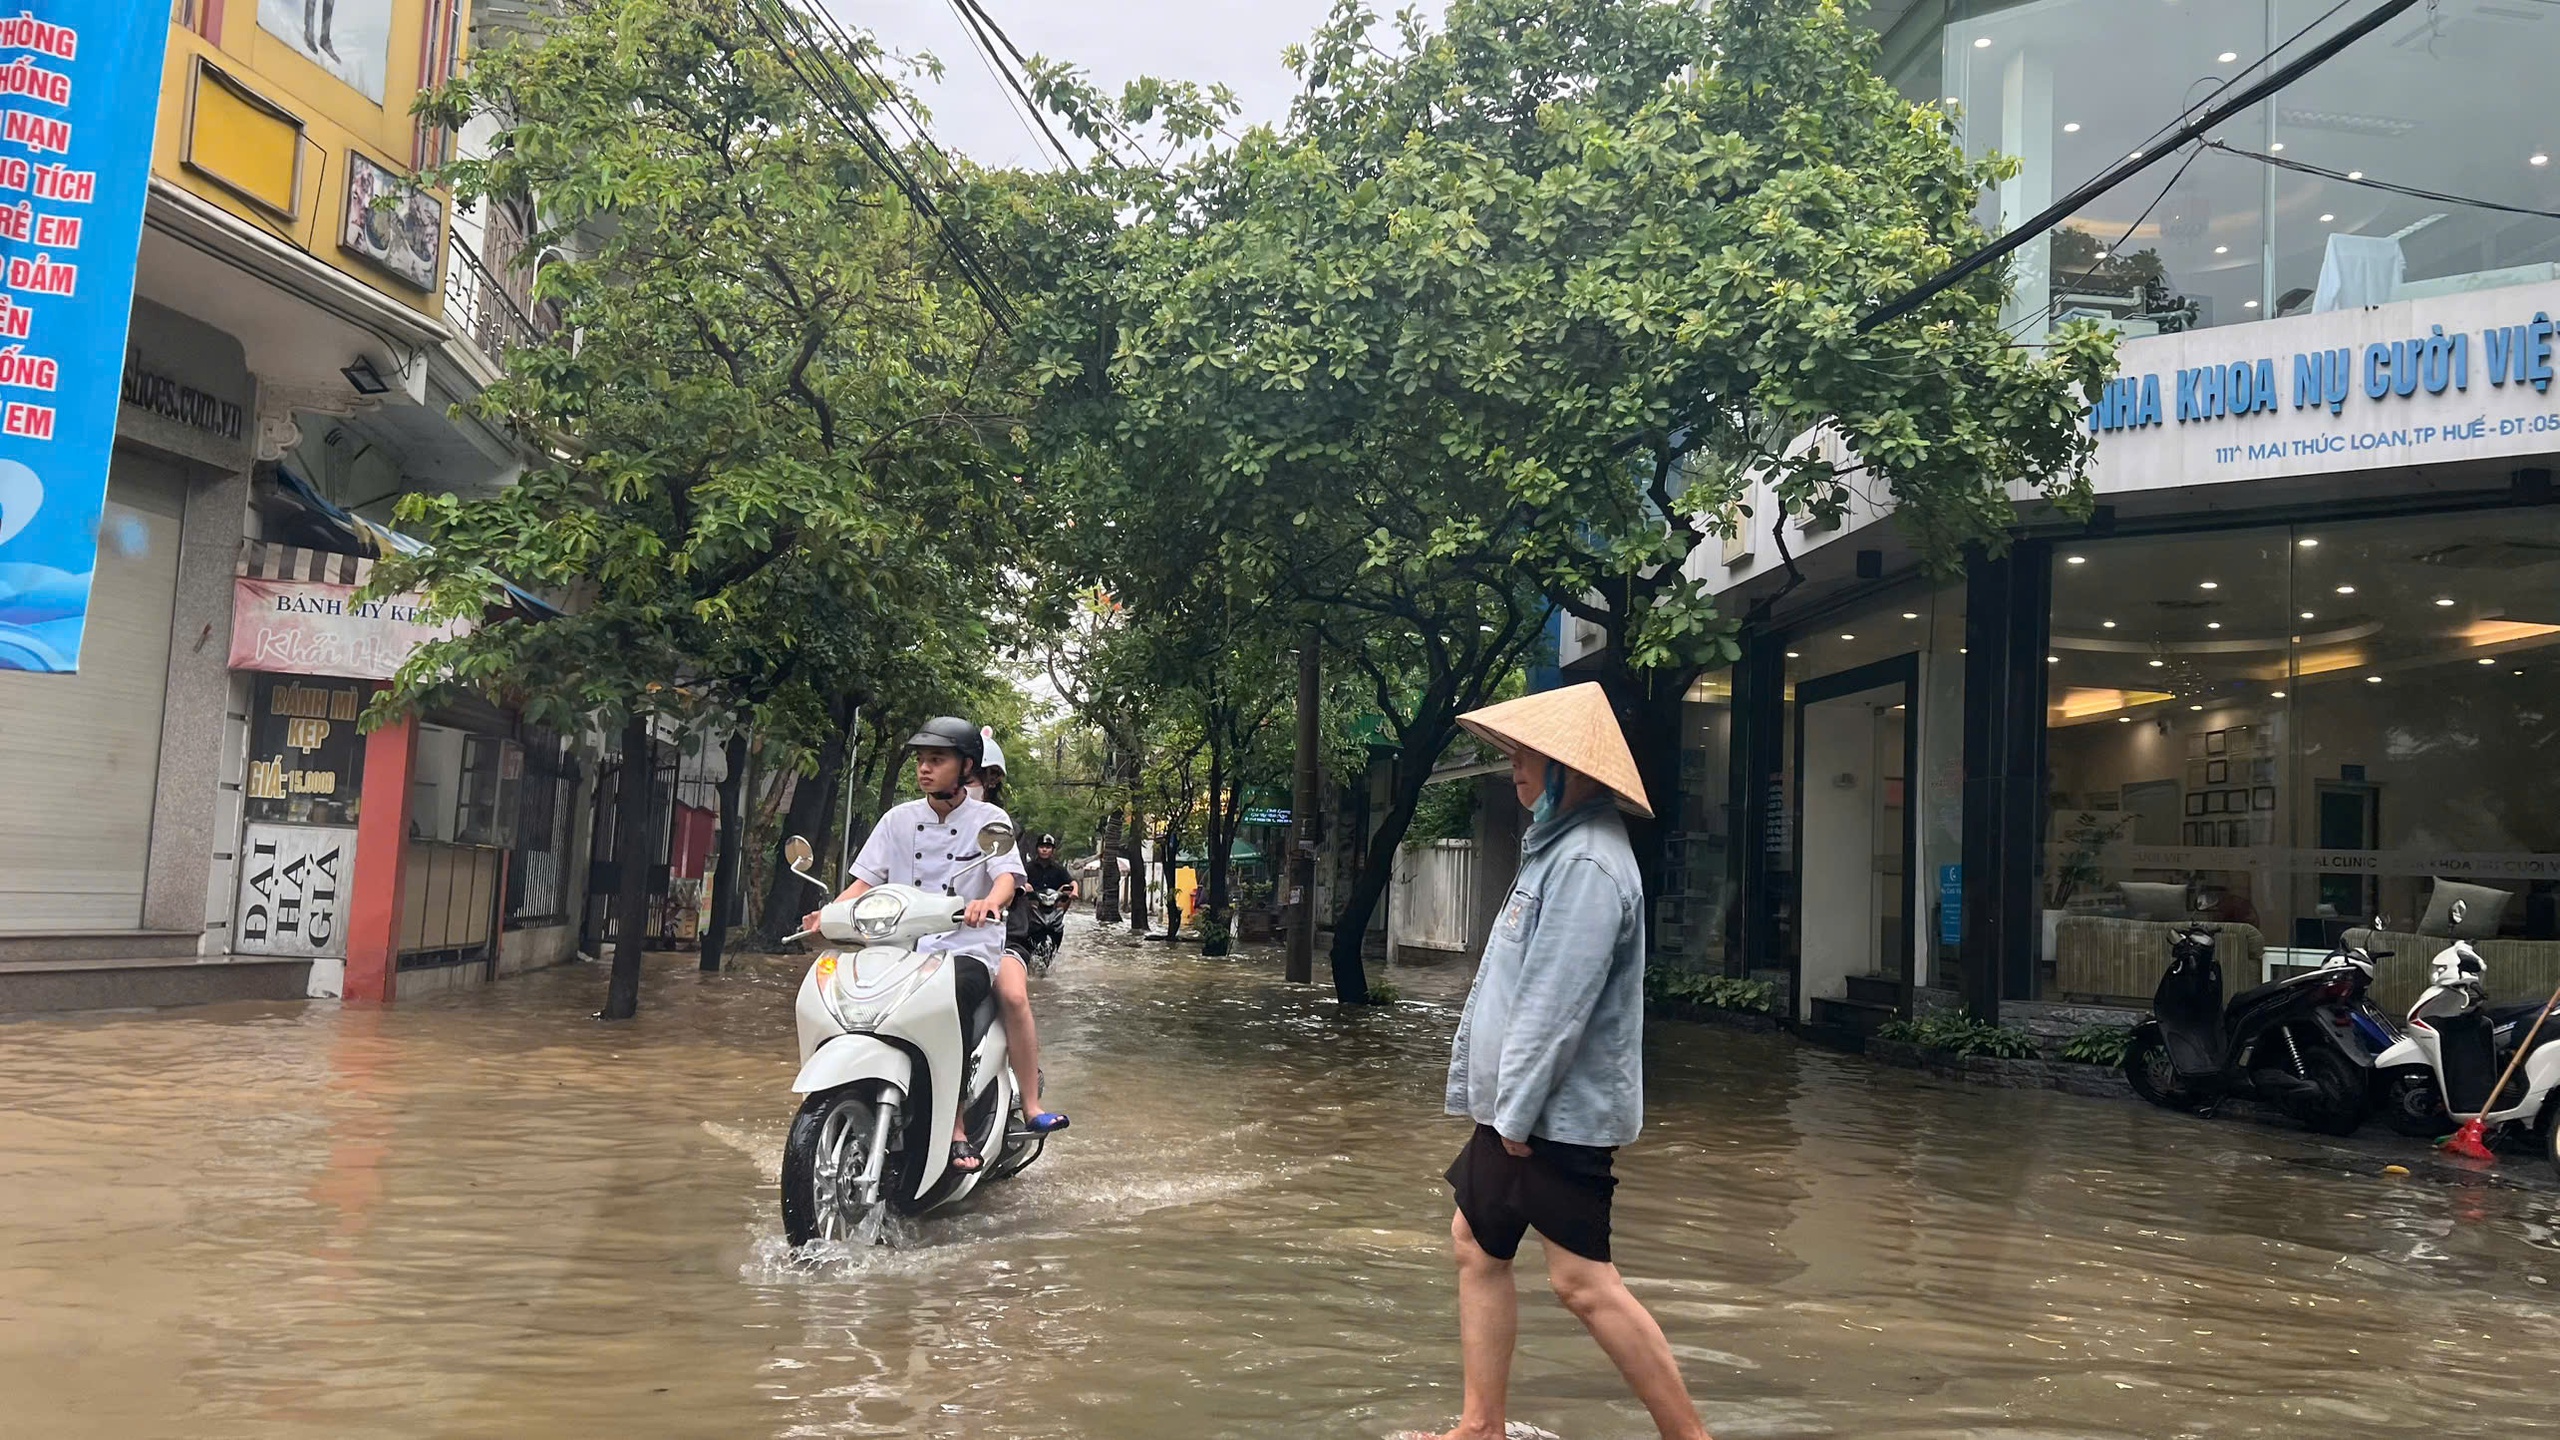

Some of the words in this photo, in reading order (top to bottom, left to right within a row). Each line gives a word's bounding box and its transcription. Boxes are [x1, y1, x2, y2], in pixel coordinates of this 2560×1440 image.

[0, 12, 76, 59] HÒNG
[5, 111, 69, 153] NẠN
[35, 164, 94, 201] TÍCH
[36, 216, 80, 247] EM
[9, 254, 75, 295] ĐẢM
[2089, 372, 2163, 433] NHA
[2176, 358, 2278, 424] KHOA
[2294, 347, 2350, 415] NỤ
[2364, 324, 2469, 399] CƯỜI
[2484, 311, 2560, 394] VIỆ
[5, 403, 54, 438] EM
[2248, 441, 2287, 461] MAI
[2292, 432, 2346, 456] THÚC
[276, 592, 342, 616] BÁNH
[271, 680, 329, 719] BÁNH
[329, 685, 358, 721] MÌ
[287, 717, 330, 755] KẸP
[248, 754, 288, 799] GIÁ:
[243, 838, 279, 945] ĐẠI
